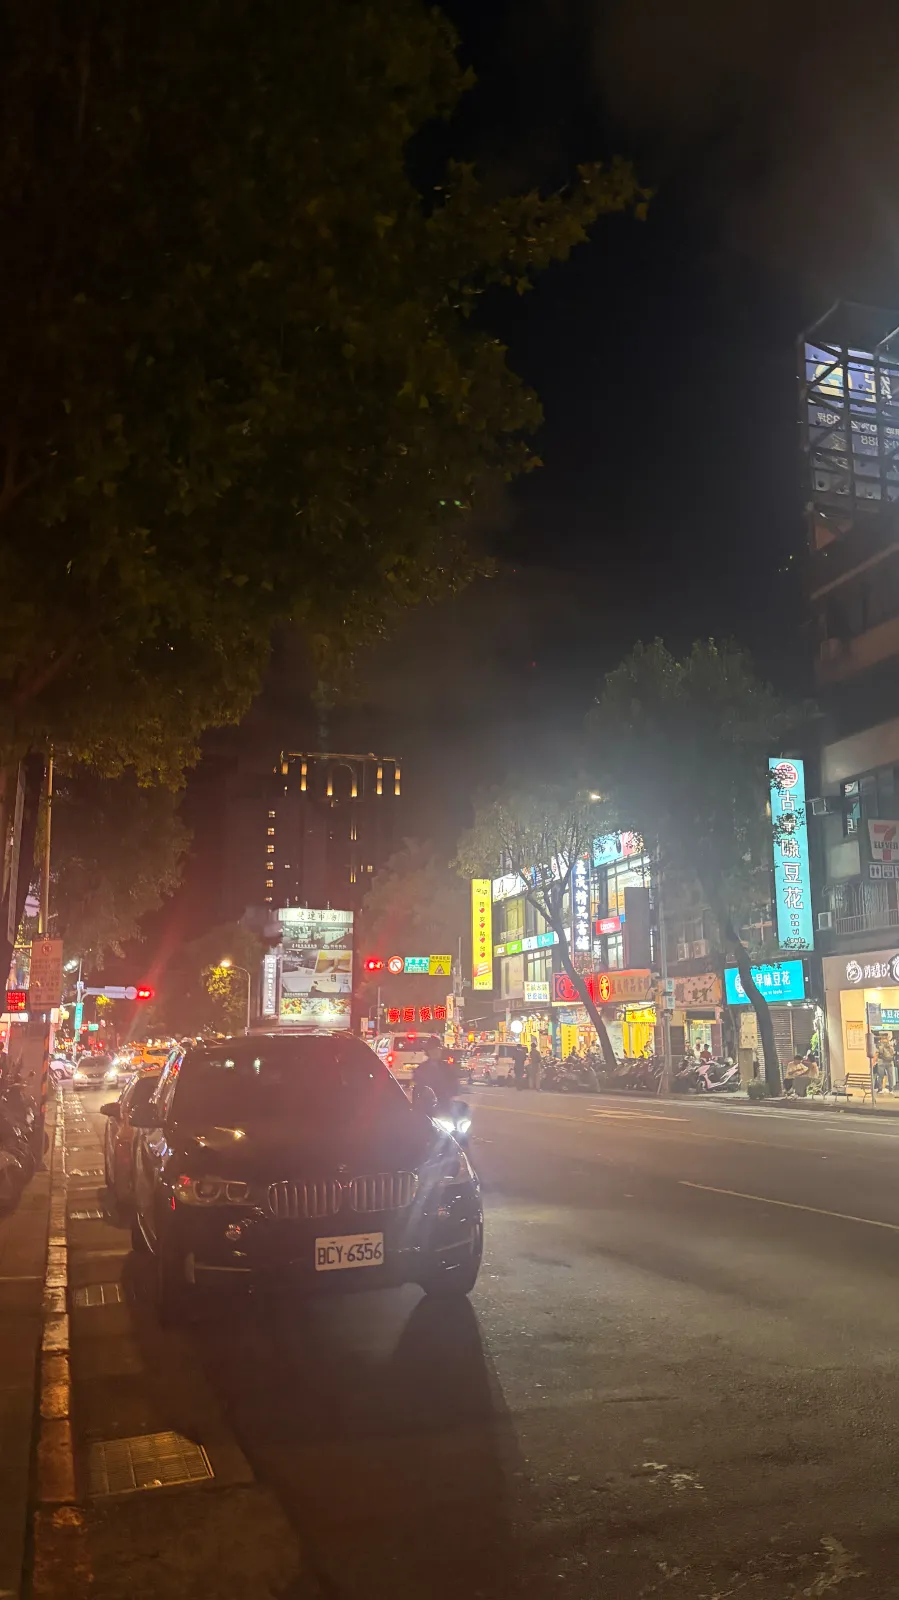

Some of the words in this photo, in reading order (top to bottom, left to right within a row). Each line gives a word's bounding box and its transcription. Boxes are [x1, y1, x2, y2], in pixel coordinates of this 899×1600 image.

[752, 971, 791, 987] 早味豆花
[317, 1242, 382, 1265] BCY-6356
